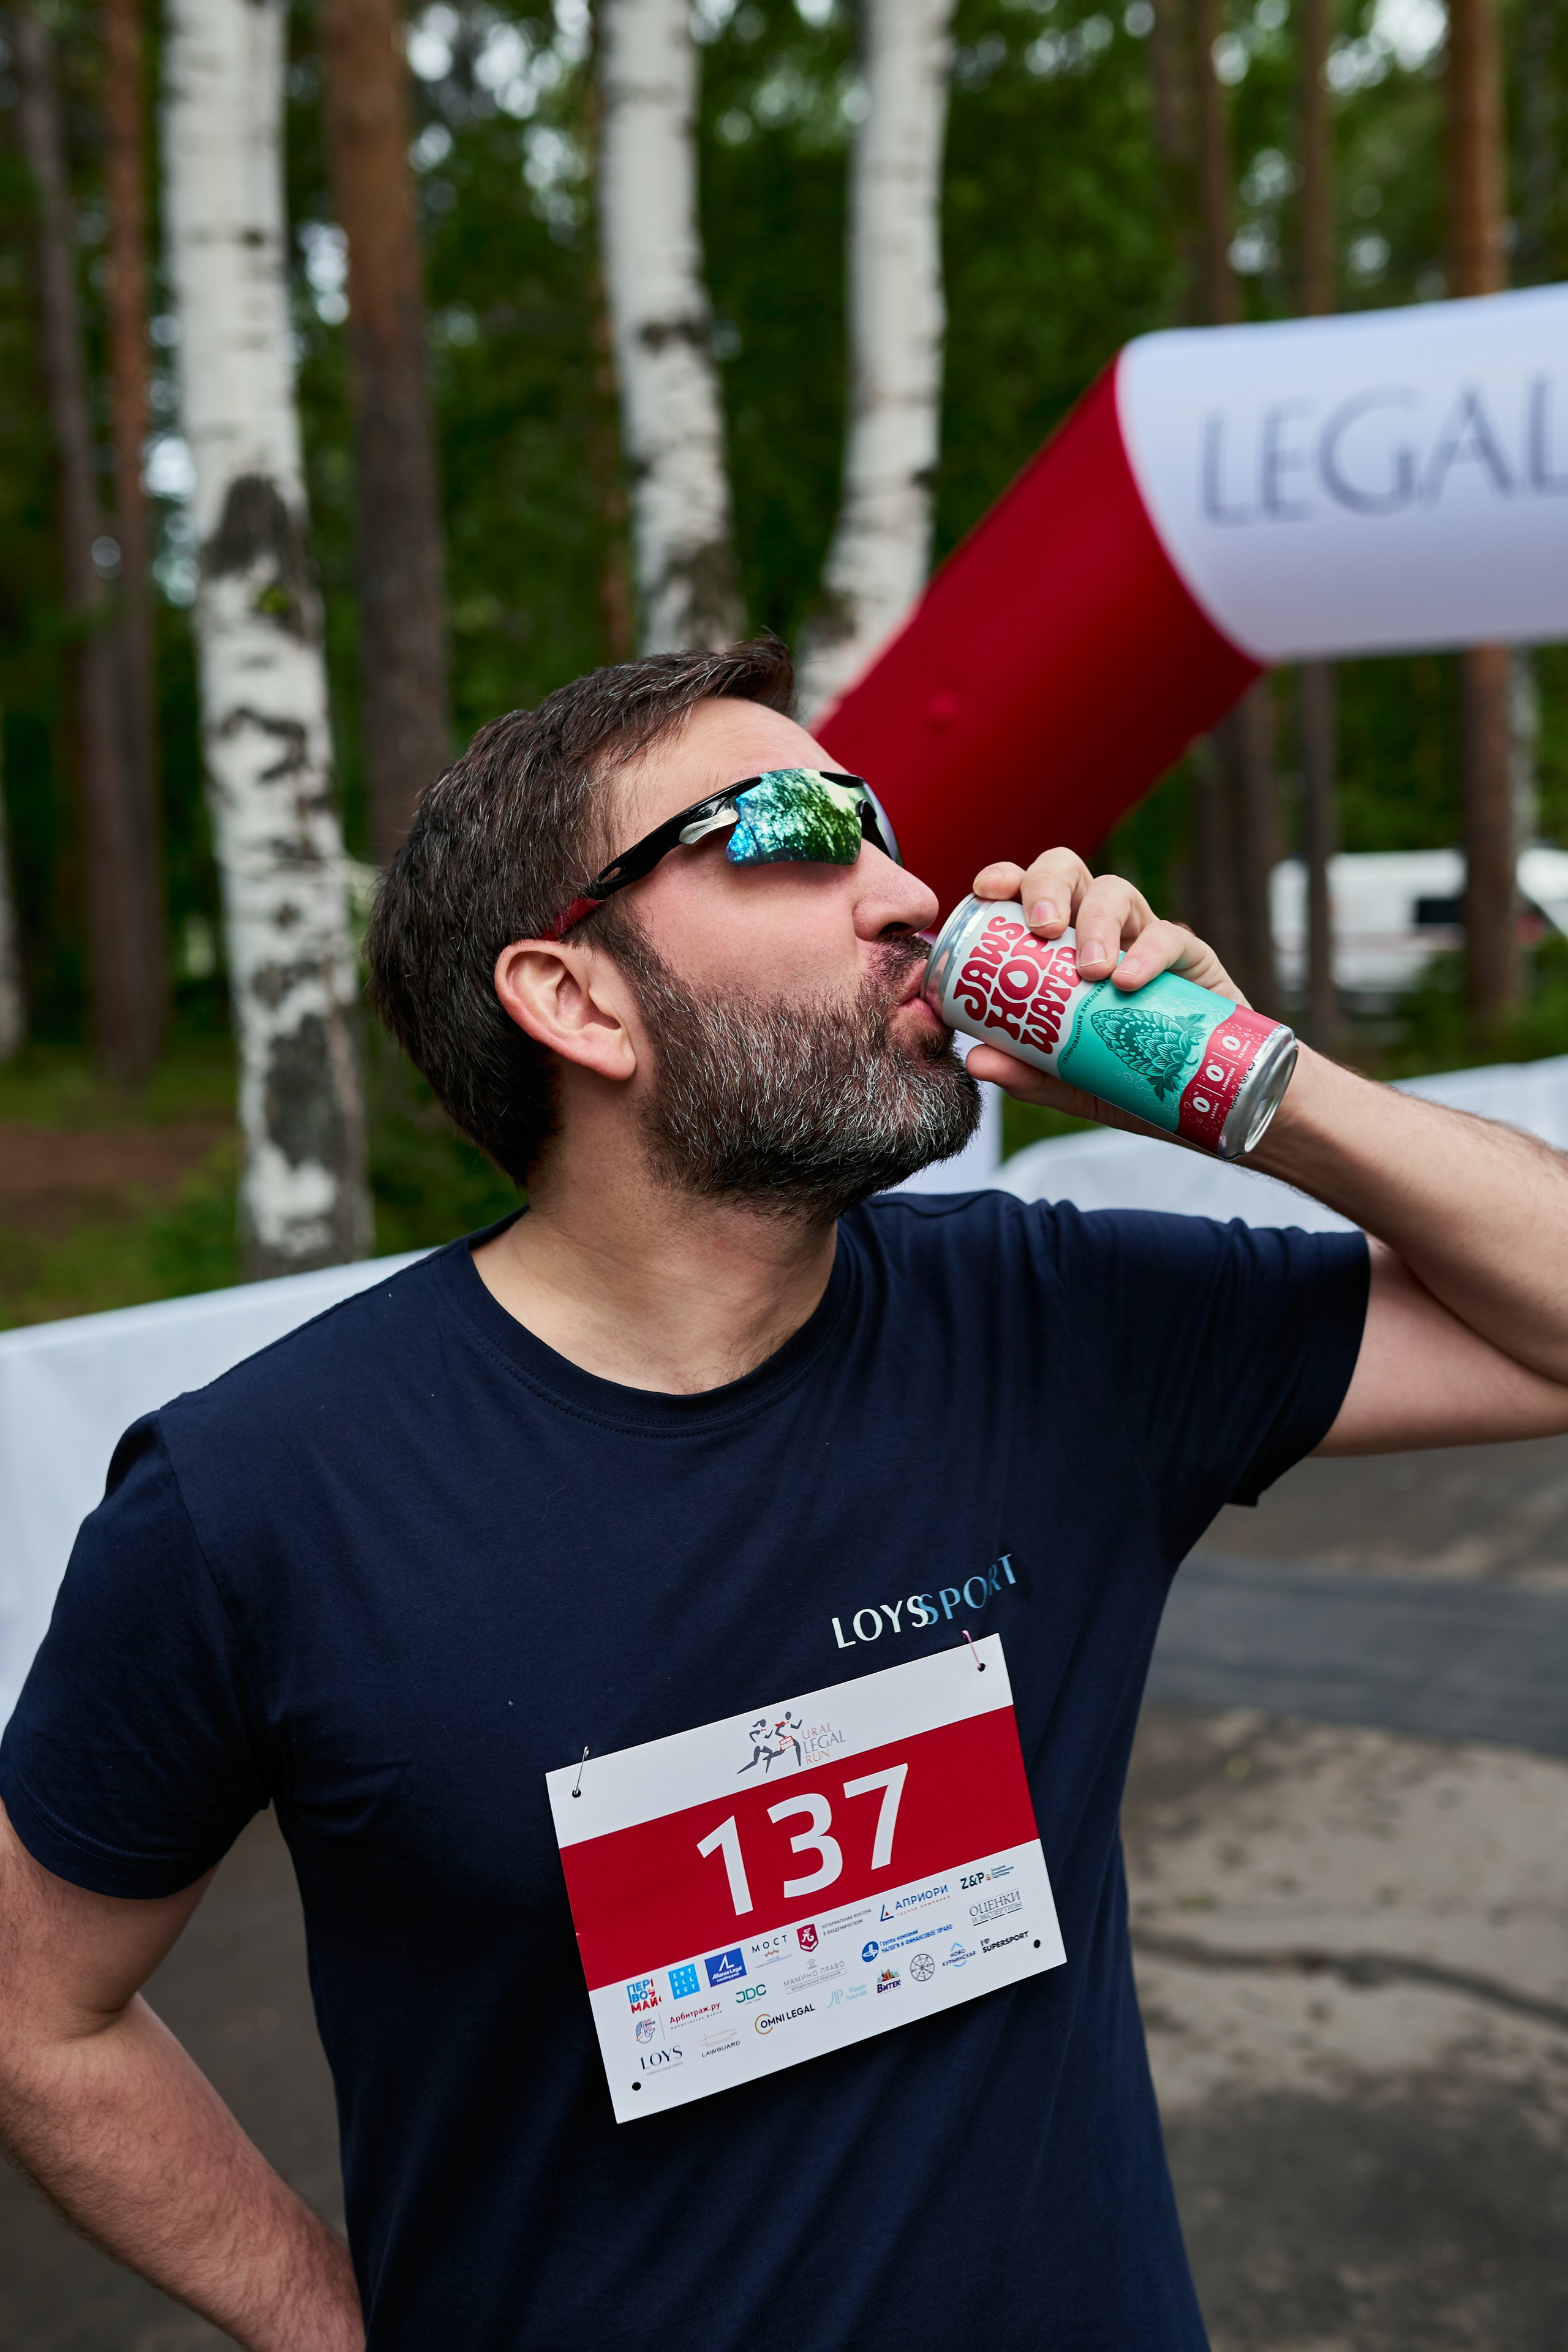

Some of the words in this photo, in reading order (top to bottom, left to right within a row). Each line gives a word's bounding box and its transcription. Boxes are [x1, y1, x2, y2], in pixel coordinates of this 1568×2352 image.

[1199, 368, 1568, 527] LEGAL
[953, 916, 1025, 1021] JAWS
[984, 932, 1054, 1041] HOP
[1062, 1015, 1084, 1064] ГАЗИРОВАННАЯ
[1221, 1067, 1236, 1091] АЛКОГОЛЯ
[1210, 1102, 1220, 1120] САХАРА
[801, 1722, 832, 1740] URAL
[803, 1730, 846, 1754] LEGAL
[805, 1750, 829, 1764] RUN
[696, 1763, 908, 1915] 137
[960, 1872, 984, 1890] Z&P
[895, 1884, 948, 1910] АПРИОРИ
[969, 1890, 1020, 1916] ОЦЕНКИ
[821, 1915, 853, 1928] НОТАРИАЛЬНАЯ
[853, 1909, 872, 1917] КОНТОРА
[827, 1918, 862, 1934] АКАДЕМИЧЕСКОМ
[752, 1934, 786, 1953] МОСТ
[879, 1937, 895, 1946] Группа
[896, 1929, 918, 1940] компаний
[881, 1943, 900, 1953] НАЛОГИ
[905, 1929, 936, 1944] ФИНАНСОВОЕ
[937, 1924, 952, 1933] ПРАВО
[982, 1931, 1028, 1953] SUPERSPORT
[942, 1950, 976, 1966] КУРЬИНСКАЯ
[712, 1970, 729, 1980] Alliance
[728, 1964, 743, 1975] Legal
[783, 1970, 818, 1986] МАМИНО
[820, 1961, 844, 1973] ПРАВО
[791, 1978, 820, 1992] ЮРИДИЧЕСКАЯ
[820, 1970, 841, 1981] КОМПАНИЯ
[736, 1983, 766, 2003] JDC
[848, 1984, 865, 1993] Роман
[669, 2002, 720, 2024] Арбитраж.ру
[760, 2013, 785, 2028] OMNI
[786, 2003, 815, 2019] LEGAL
[640, 2047, 682, 2070] LOYS
[701, 2040, 740, 2057] LAWGUARD
